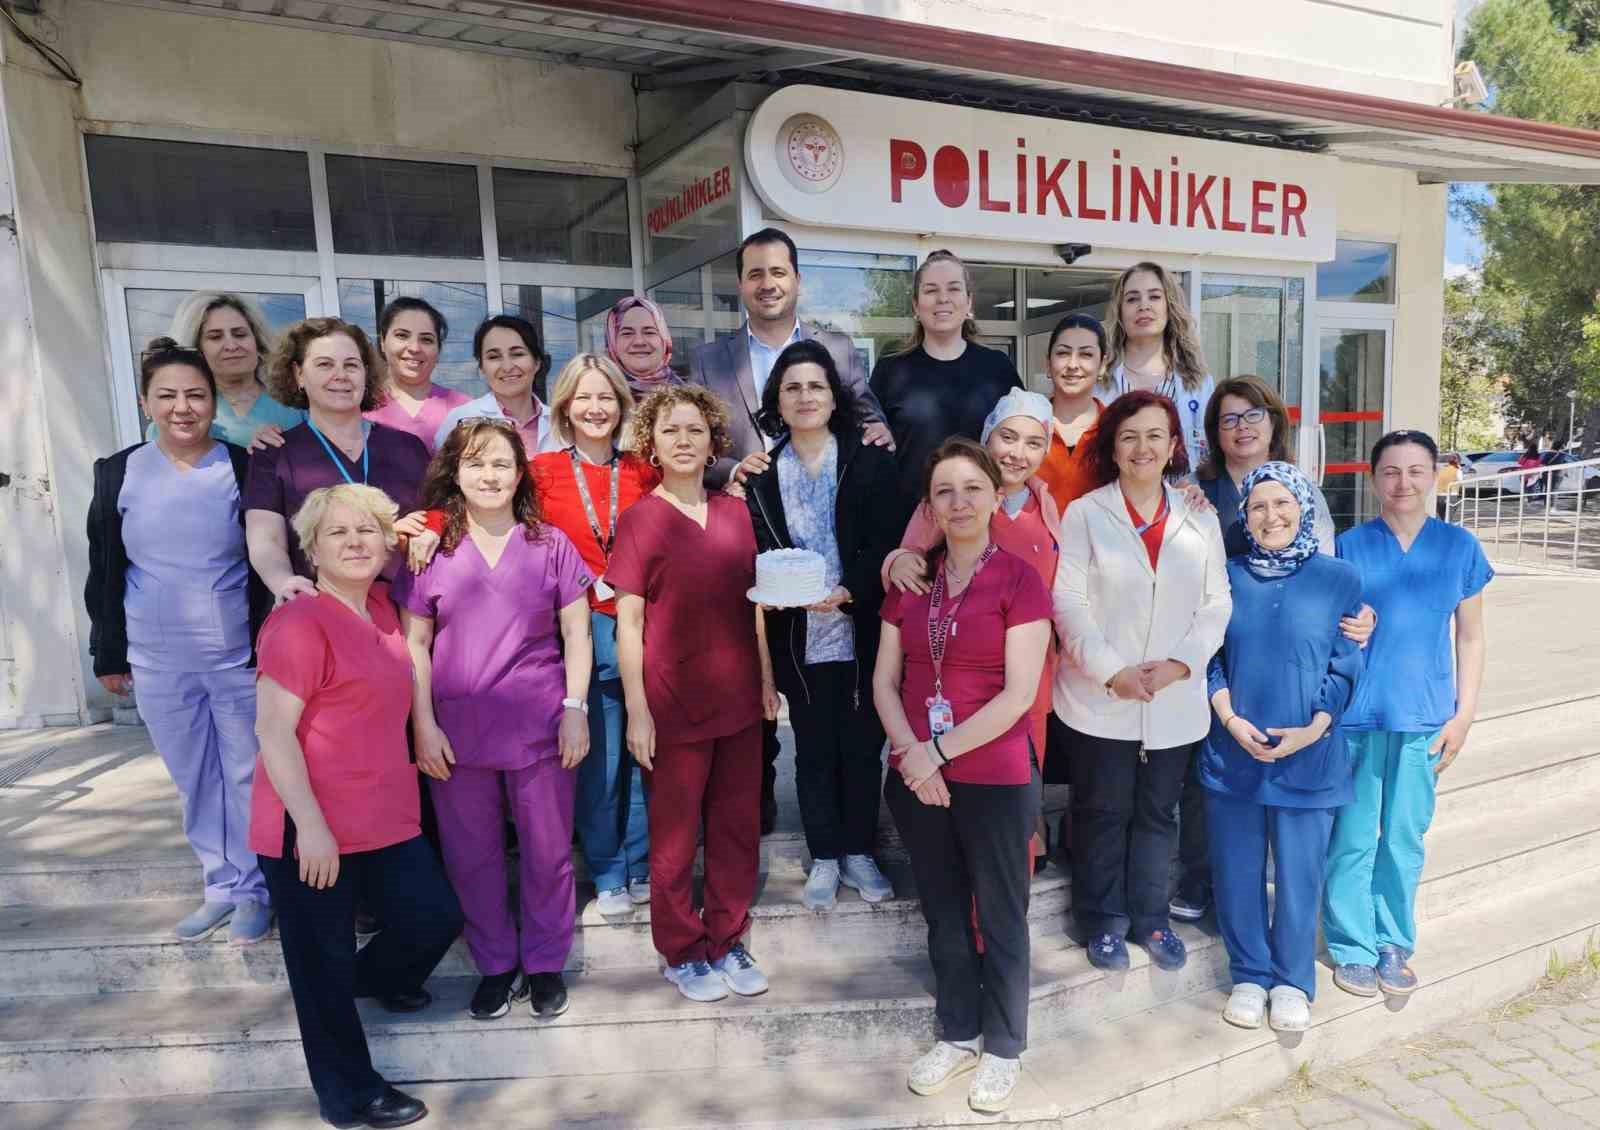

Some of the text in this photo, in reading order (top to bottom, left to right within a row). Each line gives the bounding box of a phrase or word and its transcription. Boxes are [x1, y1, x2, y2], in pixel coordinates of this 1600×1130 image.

[647, 166, 731, 233] POLİKLİNİKLER
[890, 137, 1308, 237] POLİKLİNİKLER
[928, 617, 940, 660] MIDWIFE
